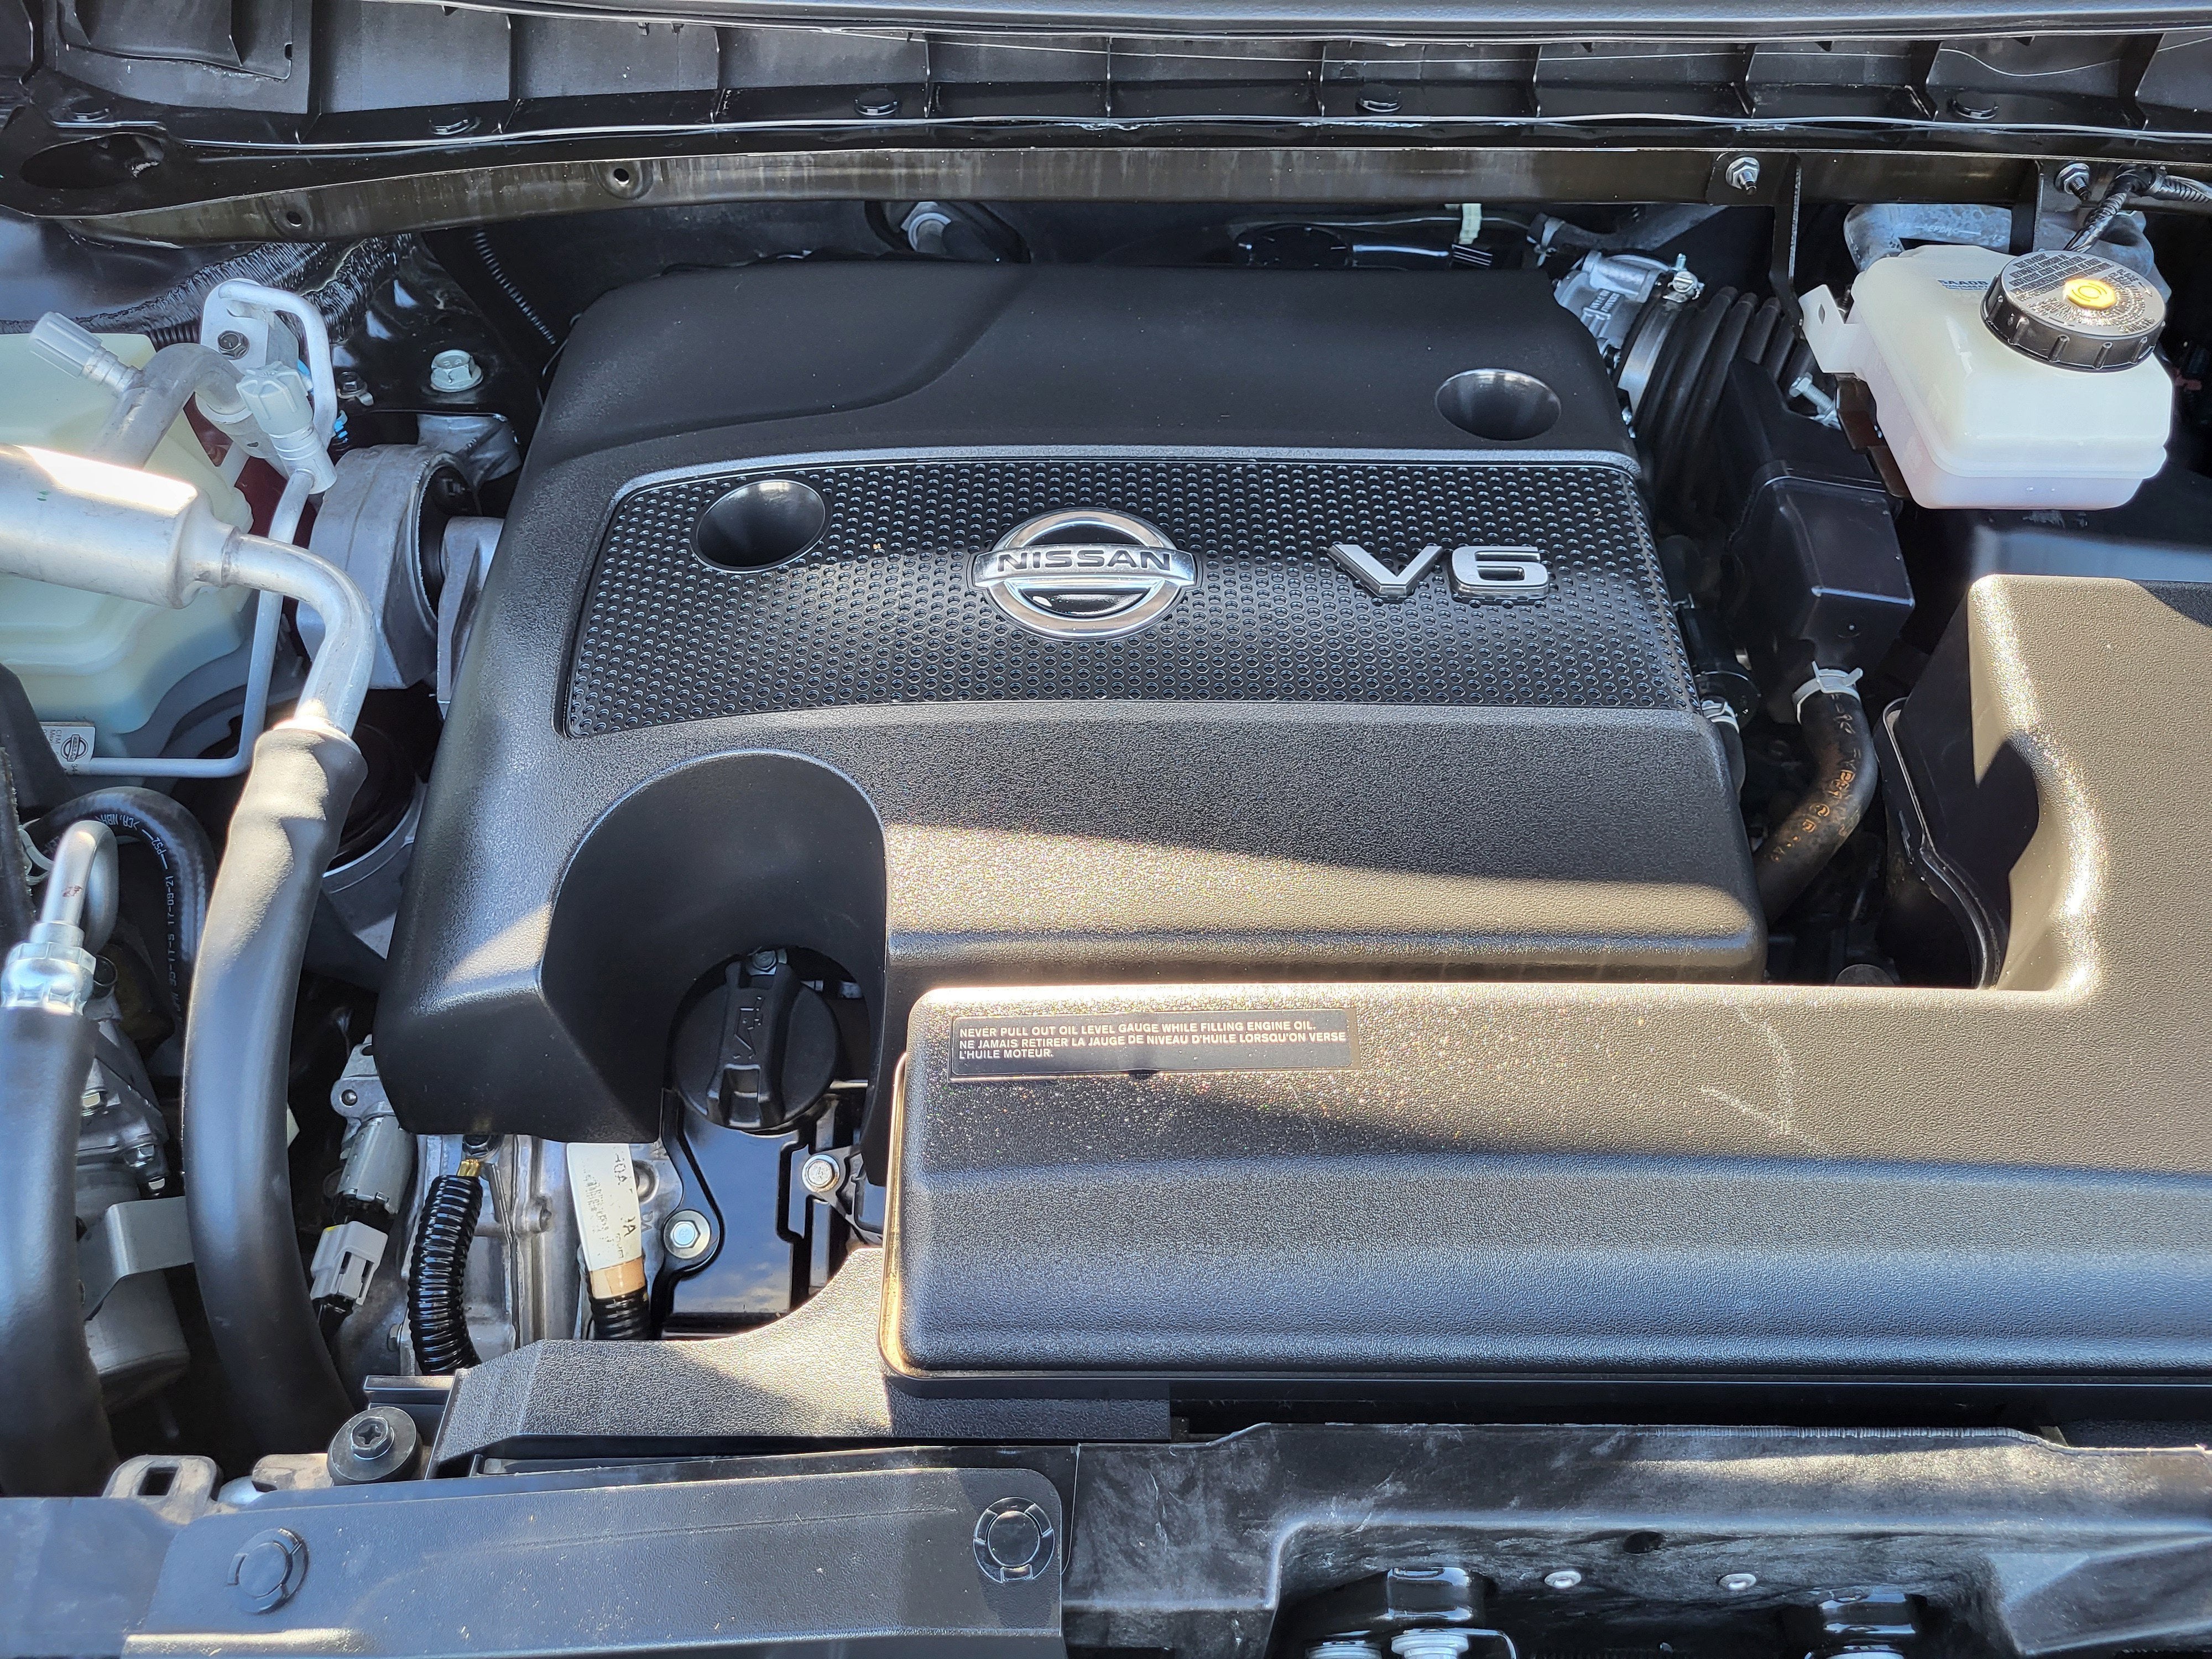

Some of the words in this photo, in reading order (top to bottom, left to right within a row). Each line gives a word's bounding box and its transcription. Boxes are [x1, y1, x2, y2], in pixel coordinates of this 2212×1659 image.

[997, 549, 1171, 572] NISSAN
[1329, 544, 1548, 598] V6
[959, 1027, 997, 1037] NEVER
[1000, 1027, 1028, 1037] PULL
[1031, 1026, 1056, 1036] OUT
[1058, 1026, 1078, 1035] OIL
[1081, 1025, 1116, 1035] LEVEL
[1118, 1022, 1159, 1033] GAUGE
[1161, 1022, 1198, 1033] WHILE
[1201, 1022, 1244, 1032] FILLING
[1247, 1021, 1291, 1031] ENGINE
[1293, 1021, 1316, 1030] OIL.
[959, 1040, 975, 1049] NE
[977, 1039, 1018, 1048] JAMAIS
[1021, 1037, 1068, 1047] RETIRER
[1071, 1037, 1086, 1047] LA
[1088, 1036, 1126, 1046] JAUGE
[1128, 1034, 1144, 1044] DE
[1146, 1035, 1188, 1045] NIVEAU
[1192, 1034, 1237, 1044] D'HUILE
[1239, 1032, 1306, 1043] LORSQU'ON
[1308, 1032, 1346, 1042] VERSE
[959, 1050, 1000, 1059] L'HUILE
[1004, 1048, 1053, 1058] MOTEUR.
